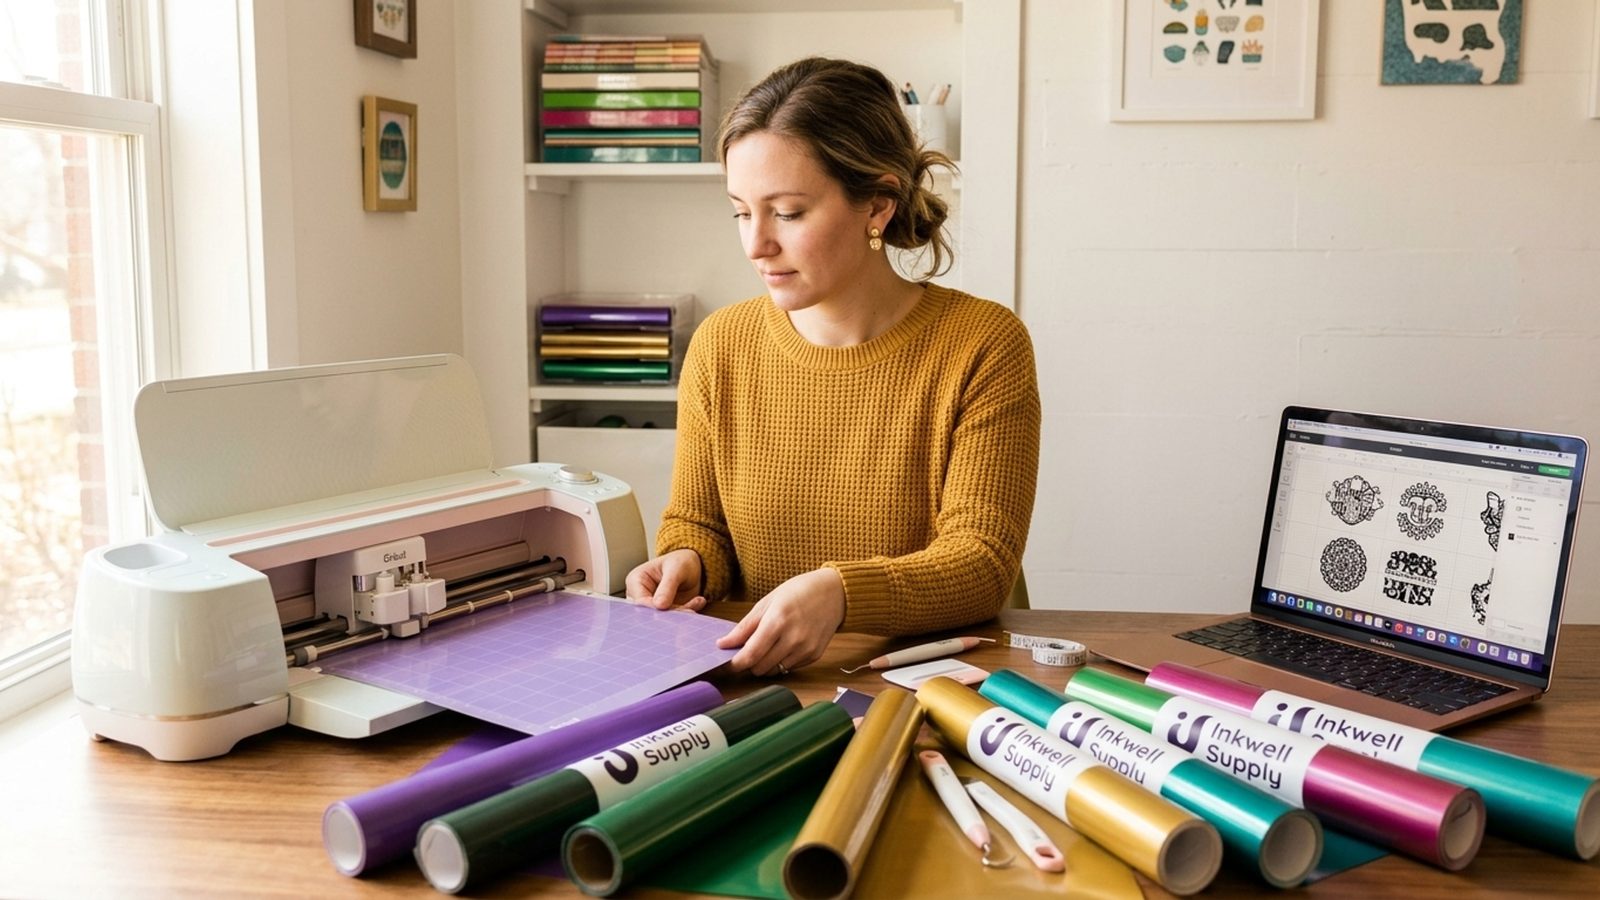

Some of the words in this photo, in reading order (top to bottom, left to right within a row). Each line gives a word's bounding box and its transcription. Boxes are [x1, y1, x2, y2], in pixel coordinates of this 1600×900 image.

[643, 731, 710, 765] Supply
[1014, 729, 1076, 768] Inkwell
[1096, 724, 1165, 764] Inkwell
[1211, 722, 1293, 763] Inkwell
[1314, 713, 1404, 752] Inkwell
[1004, 744, 1055, 792] Supply
[1206, 744, 1281, 789] Supply
